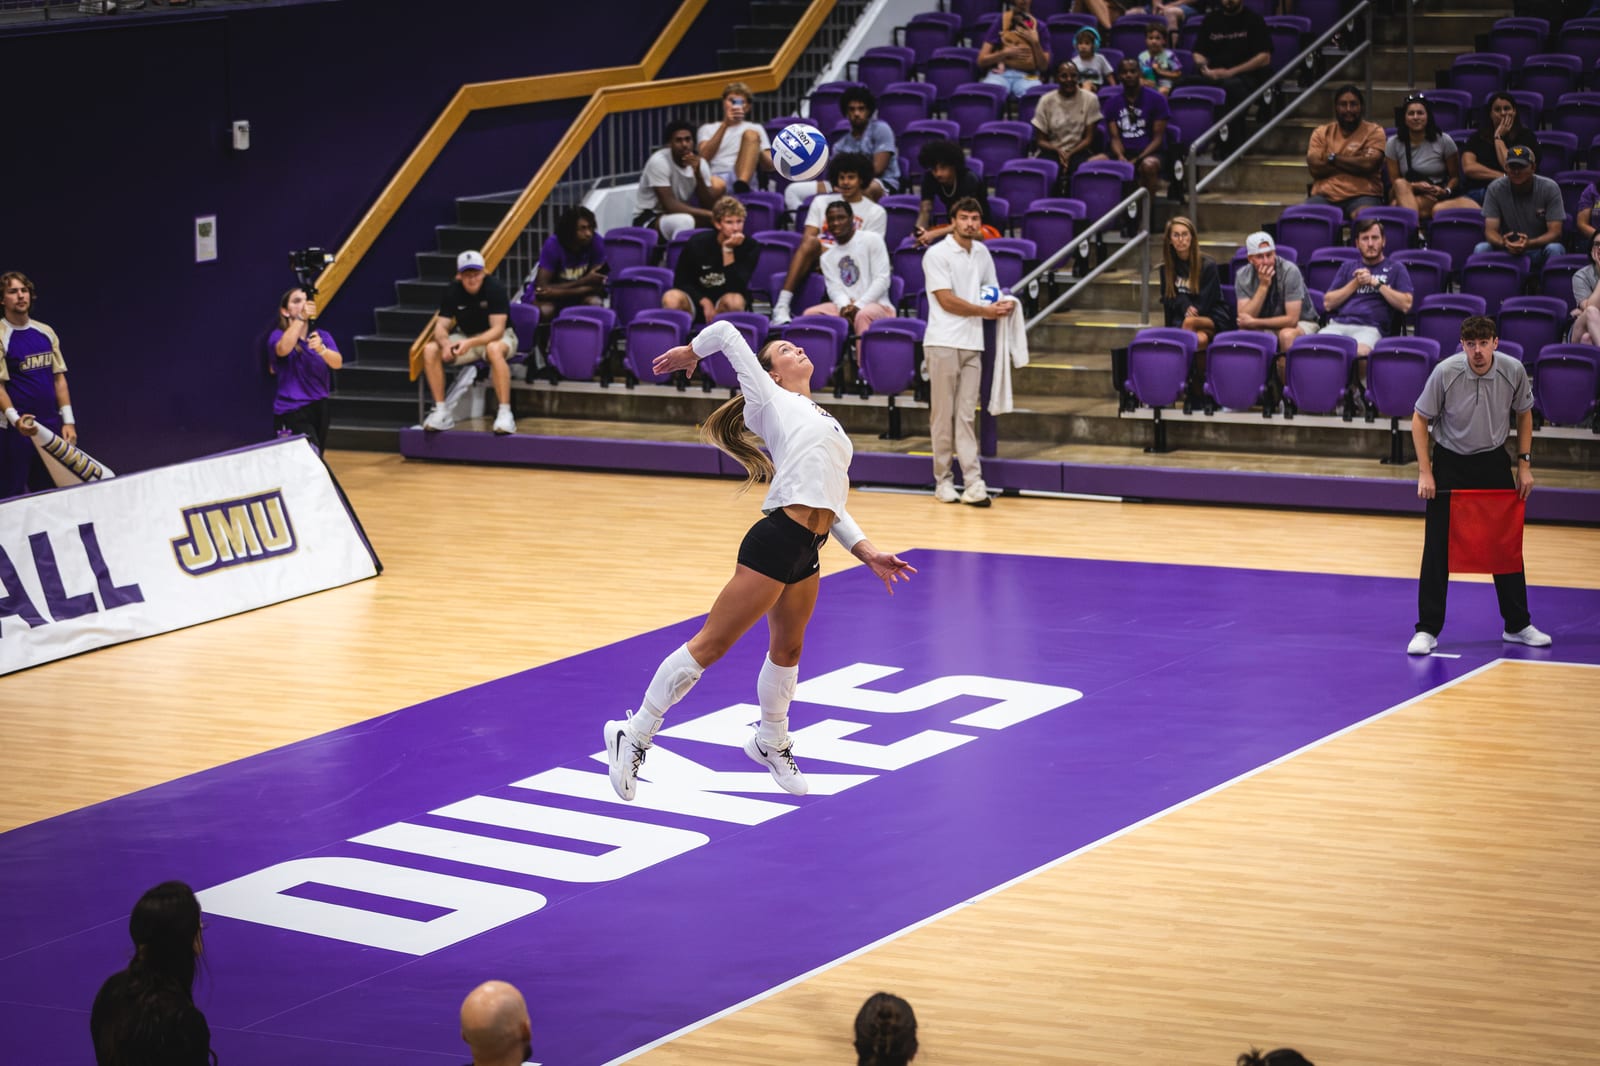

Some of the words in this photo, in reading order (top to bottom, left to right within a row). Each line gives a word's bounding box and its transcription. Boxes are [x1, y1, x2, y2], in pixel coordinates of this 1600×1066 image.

[21, 352, 54, 371] JMU
[175, 494, 294, 572] JMU
[197, 663, 1083, 956] DUKES
